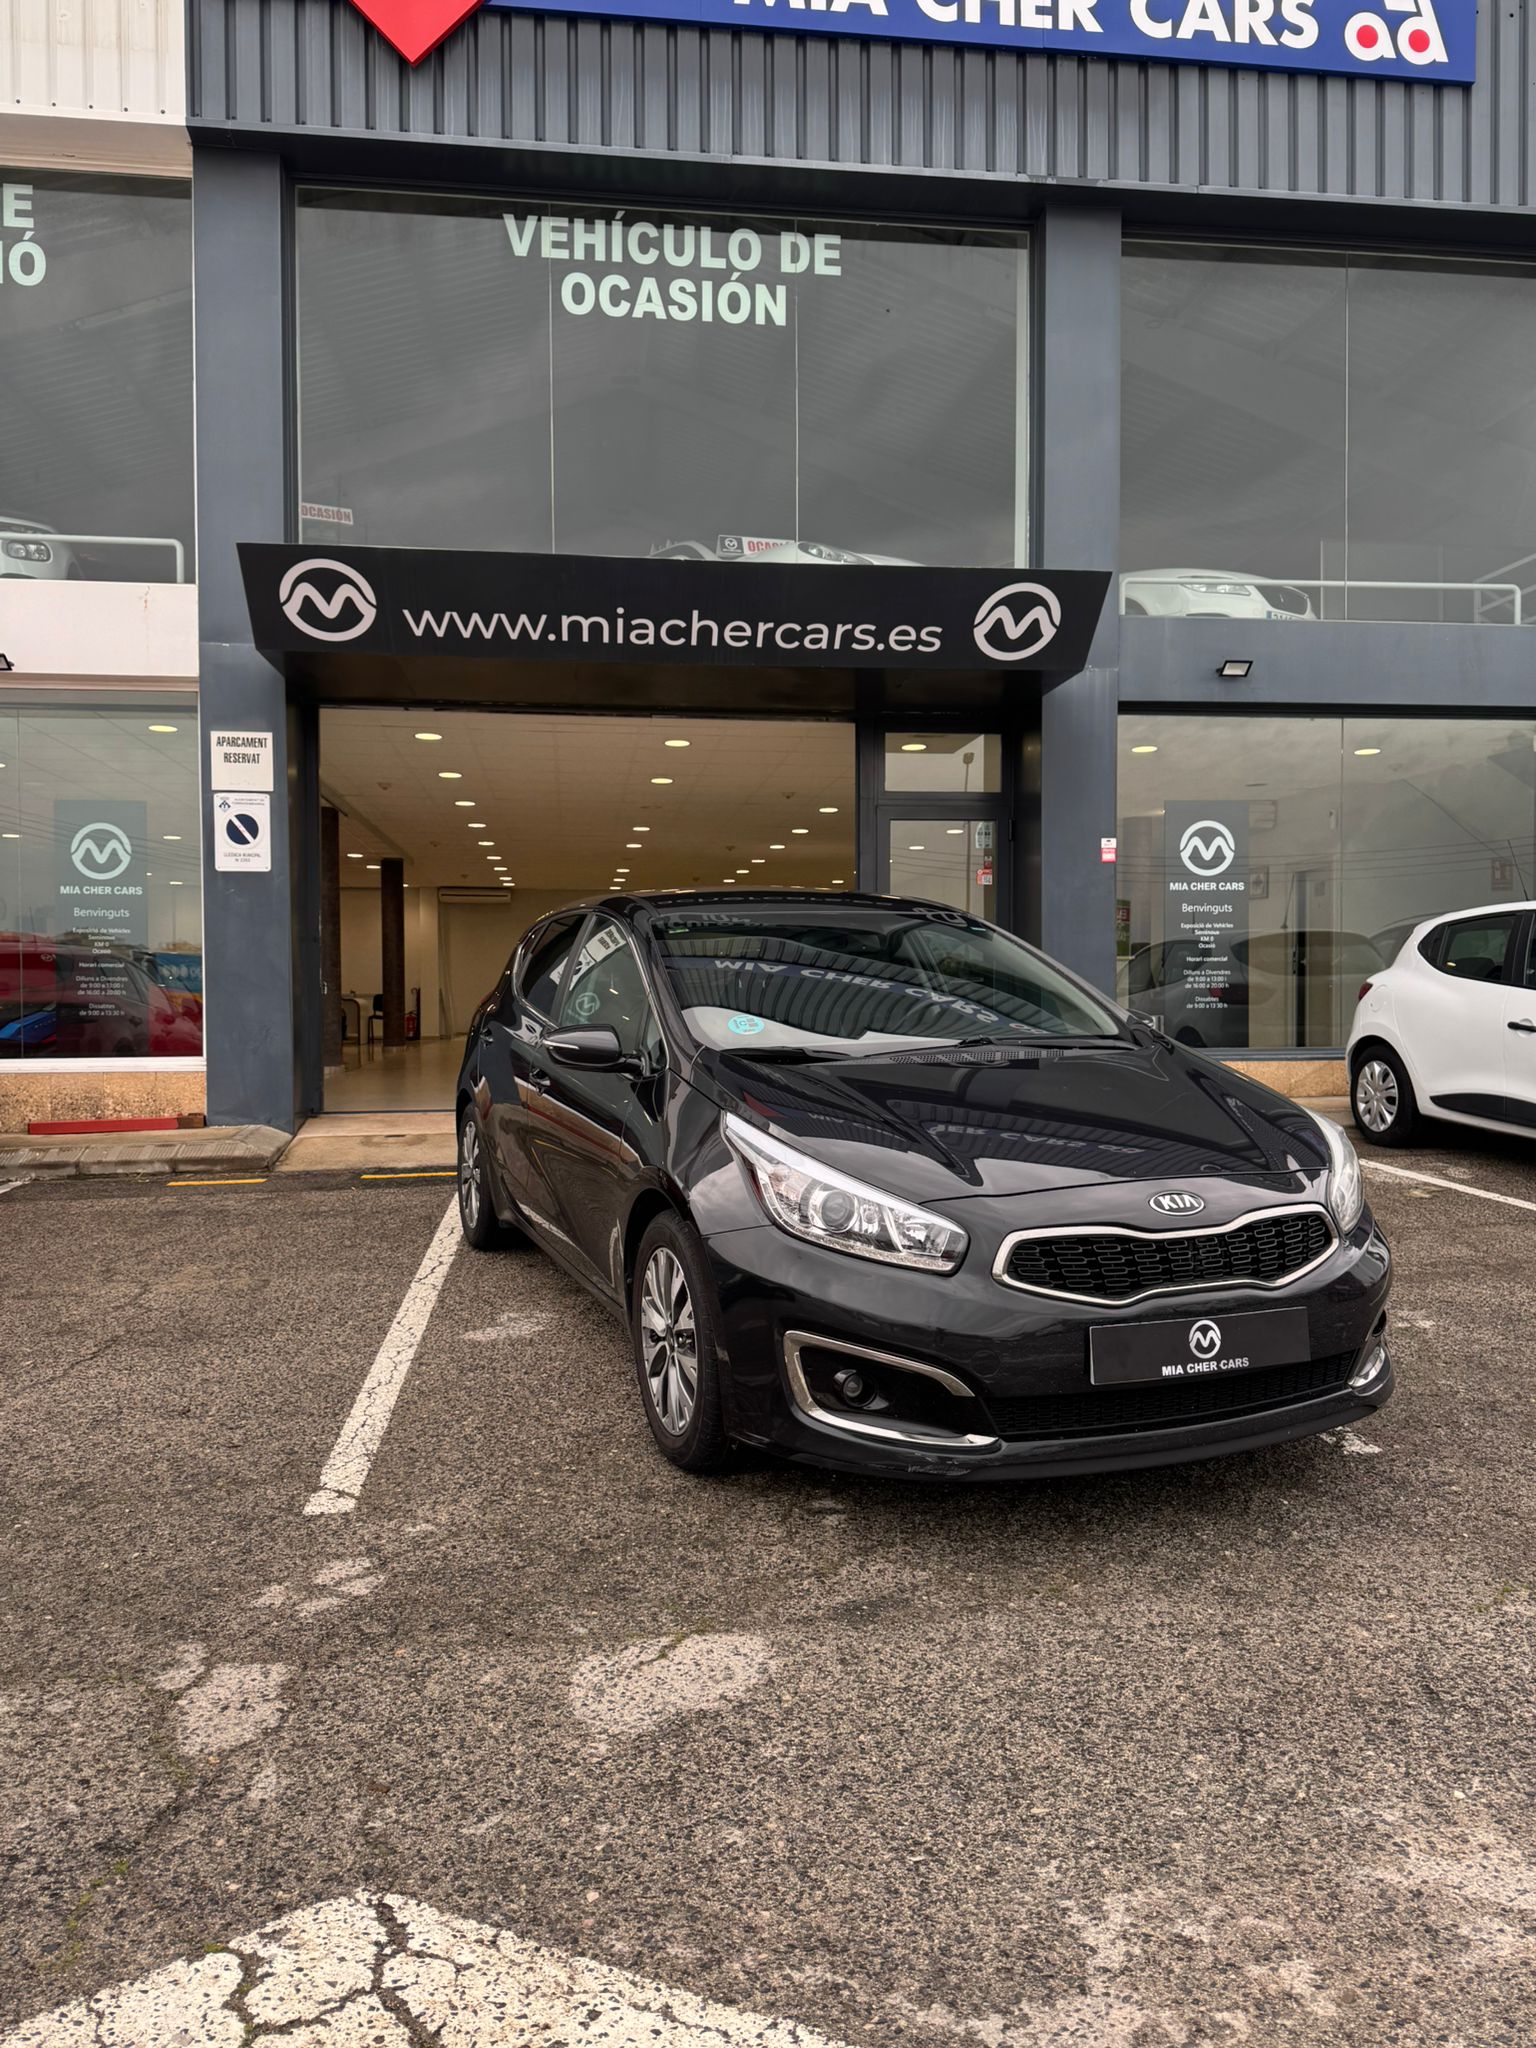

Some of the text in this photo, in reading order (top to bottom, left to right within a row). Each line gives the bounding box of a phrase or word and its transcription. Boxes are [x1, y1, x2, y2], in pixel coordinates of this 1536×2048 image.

[502, 211, 842, 276] VEHÍCULO DE
[561, 272, 786, 326] OCASIÓN
[402, 607, 943, 652] www.miachercars.es
[216, 736, 268, 748] APARCAMENT
[223, 752, 261, 764] RESERVAT
[60, 886, 143, 895] MIA CHER CARS
[1169, 882, 1245, 891] MIA CHER CARS
[73, 907, 130, 919] Benvinguts
[1182, 903, 1233, 914] Benvinguts
[1157, 1194, 1200, 1210] KIA
[1161, 1357, 1250, 1376] MIA CHER CARS
